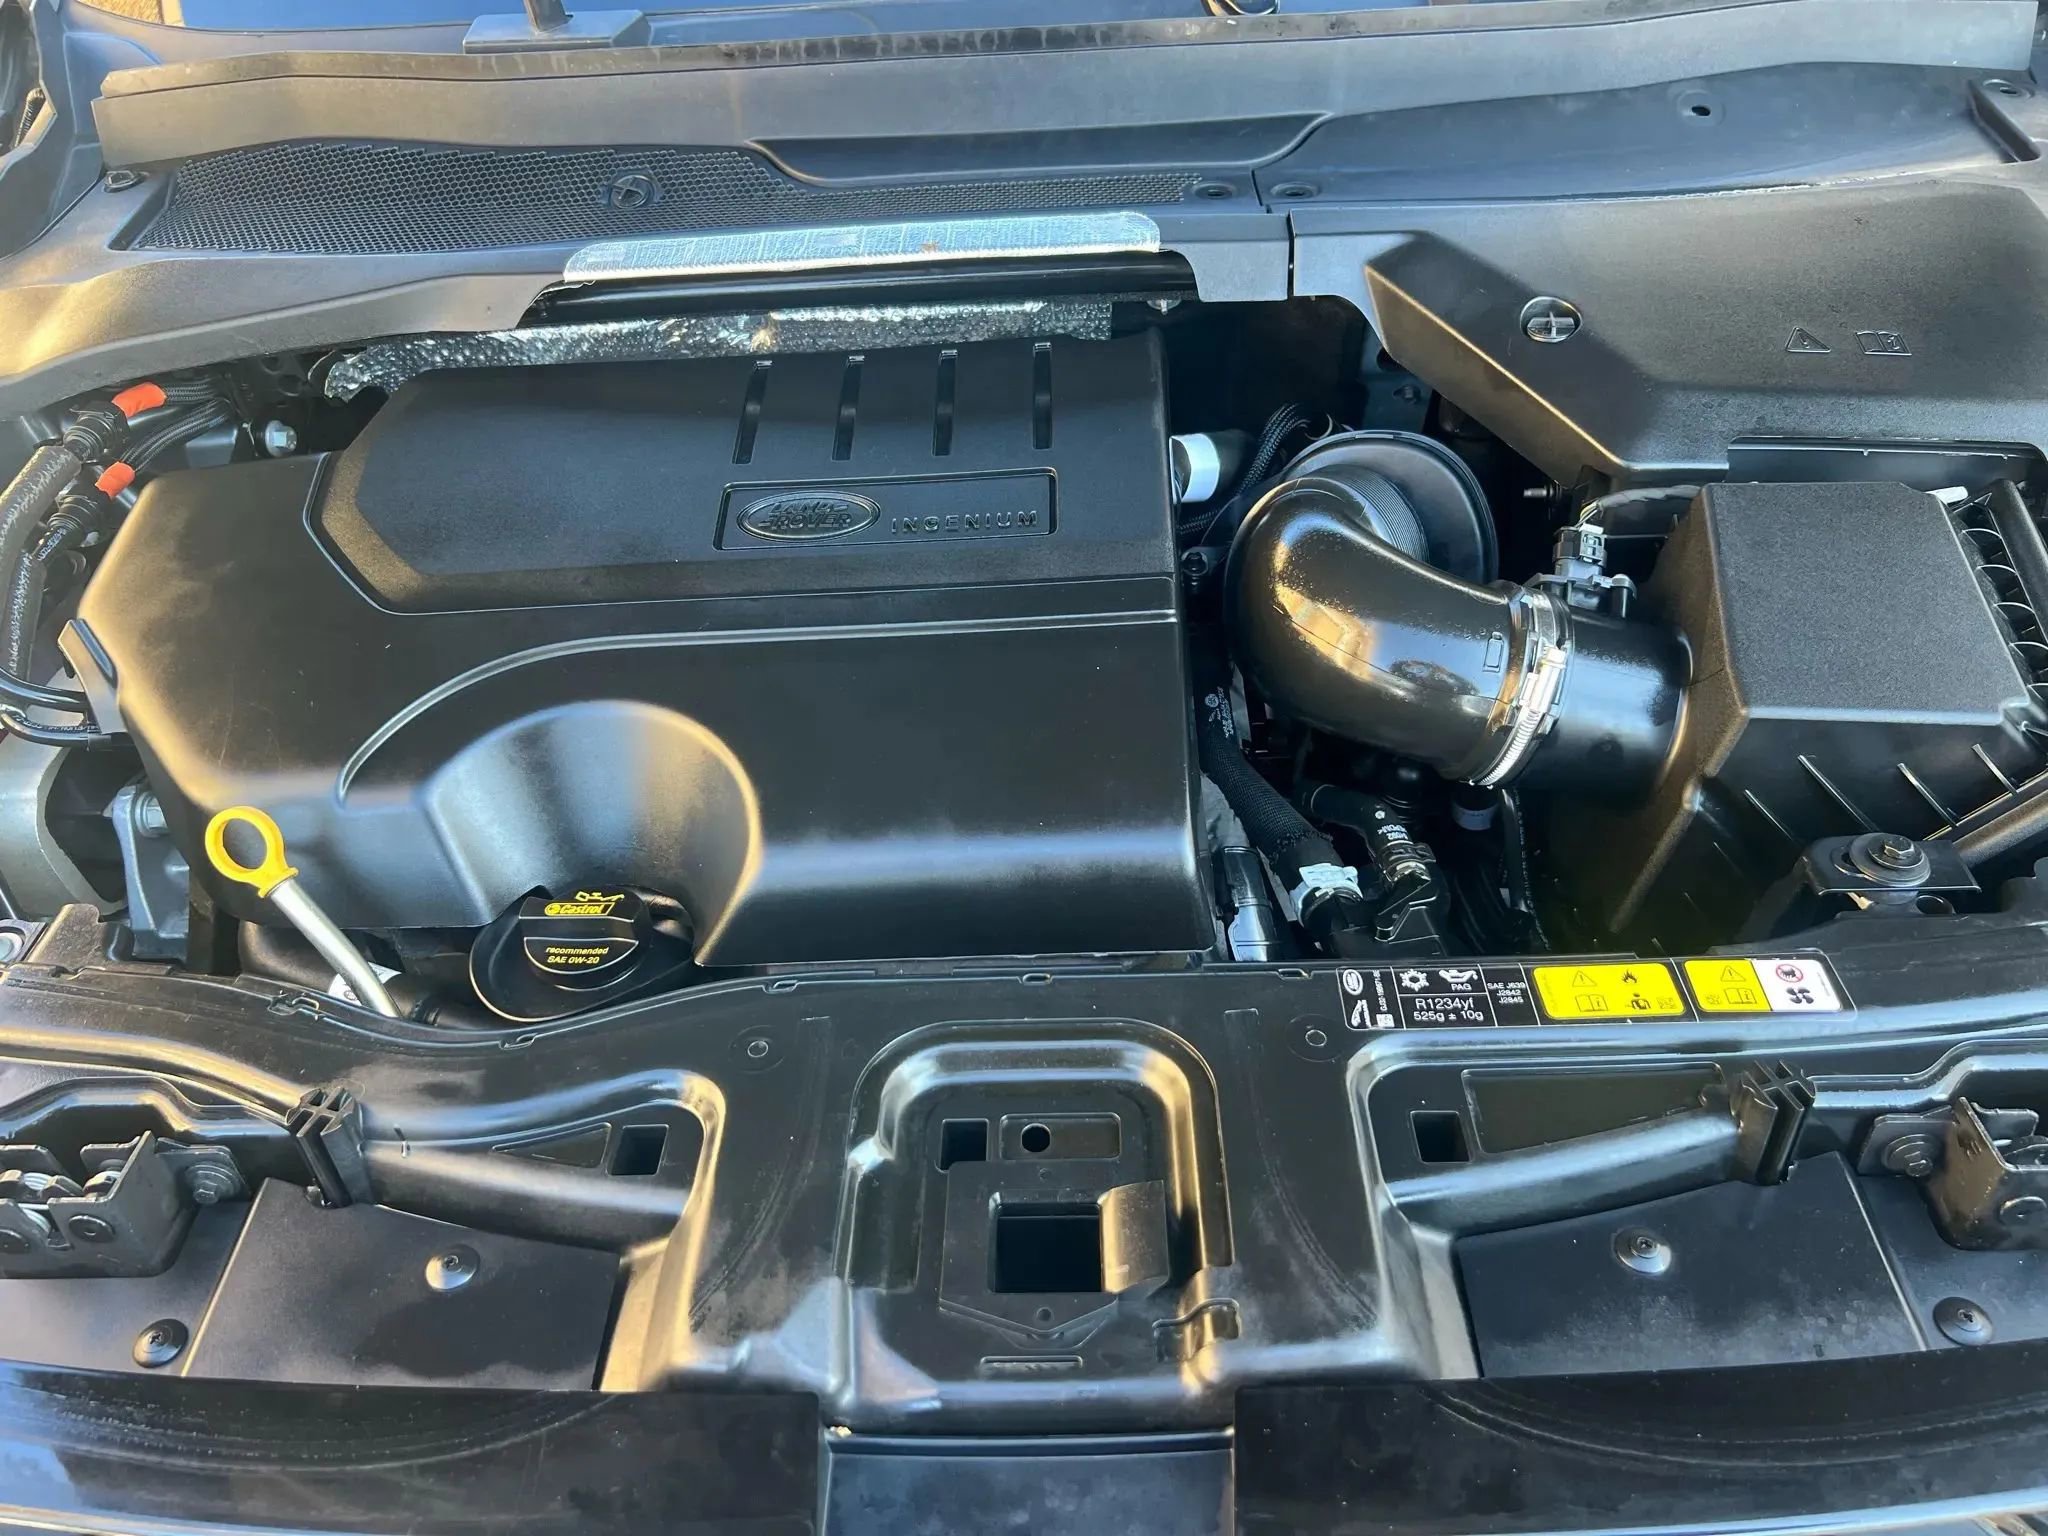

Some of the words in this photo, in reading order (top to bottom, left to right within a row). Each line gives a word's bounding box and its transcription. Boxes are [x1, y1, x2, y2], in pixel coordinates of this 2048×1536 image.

[770, 513, 852, 530] ROVER
[891, 510, 1038, 533] INGENIUM
[559, 903, 604, 914] Castrol
[546, 946, 609, 955] recommended
[547, 956, 567, 964] SAE
[568, 956, 600, 964] 0W-20
[1451, 983, 1472, 991] PAG
[1415, 998, 1475, 1010] R1234yf
[1413, 1011, 1445, 1022] 525g
[1461, 1010, 1483, 1021] 10g
